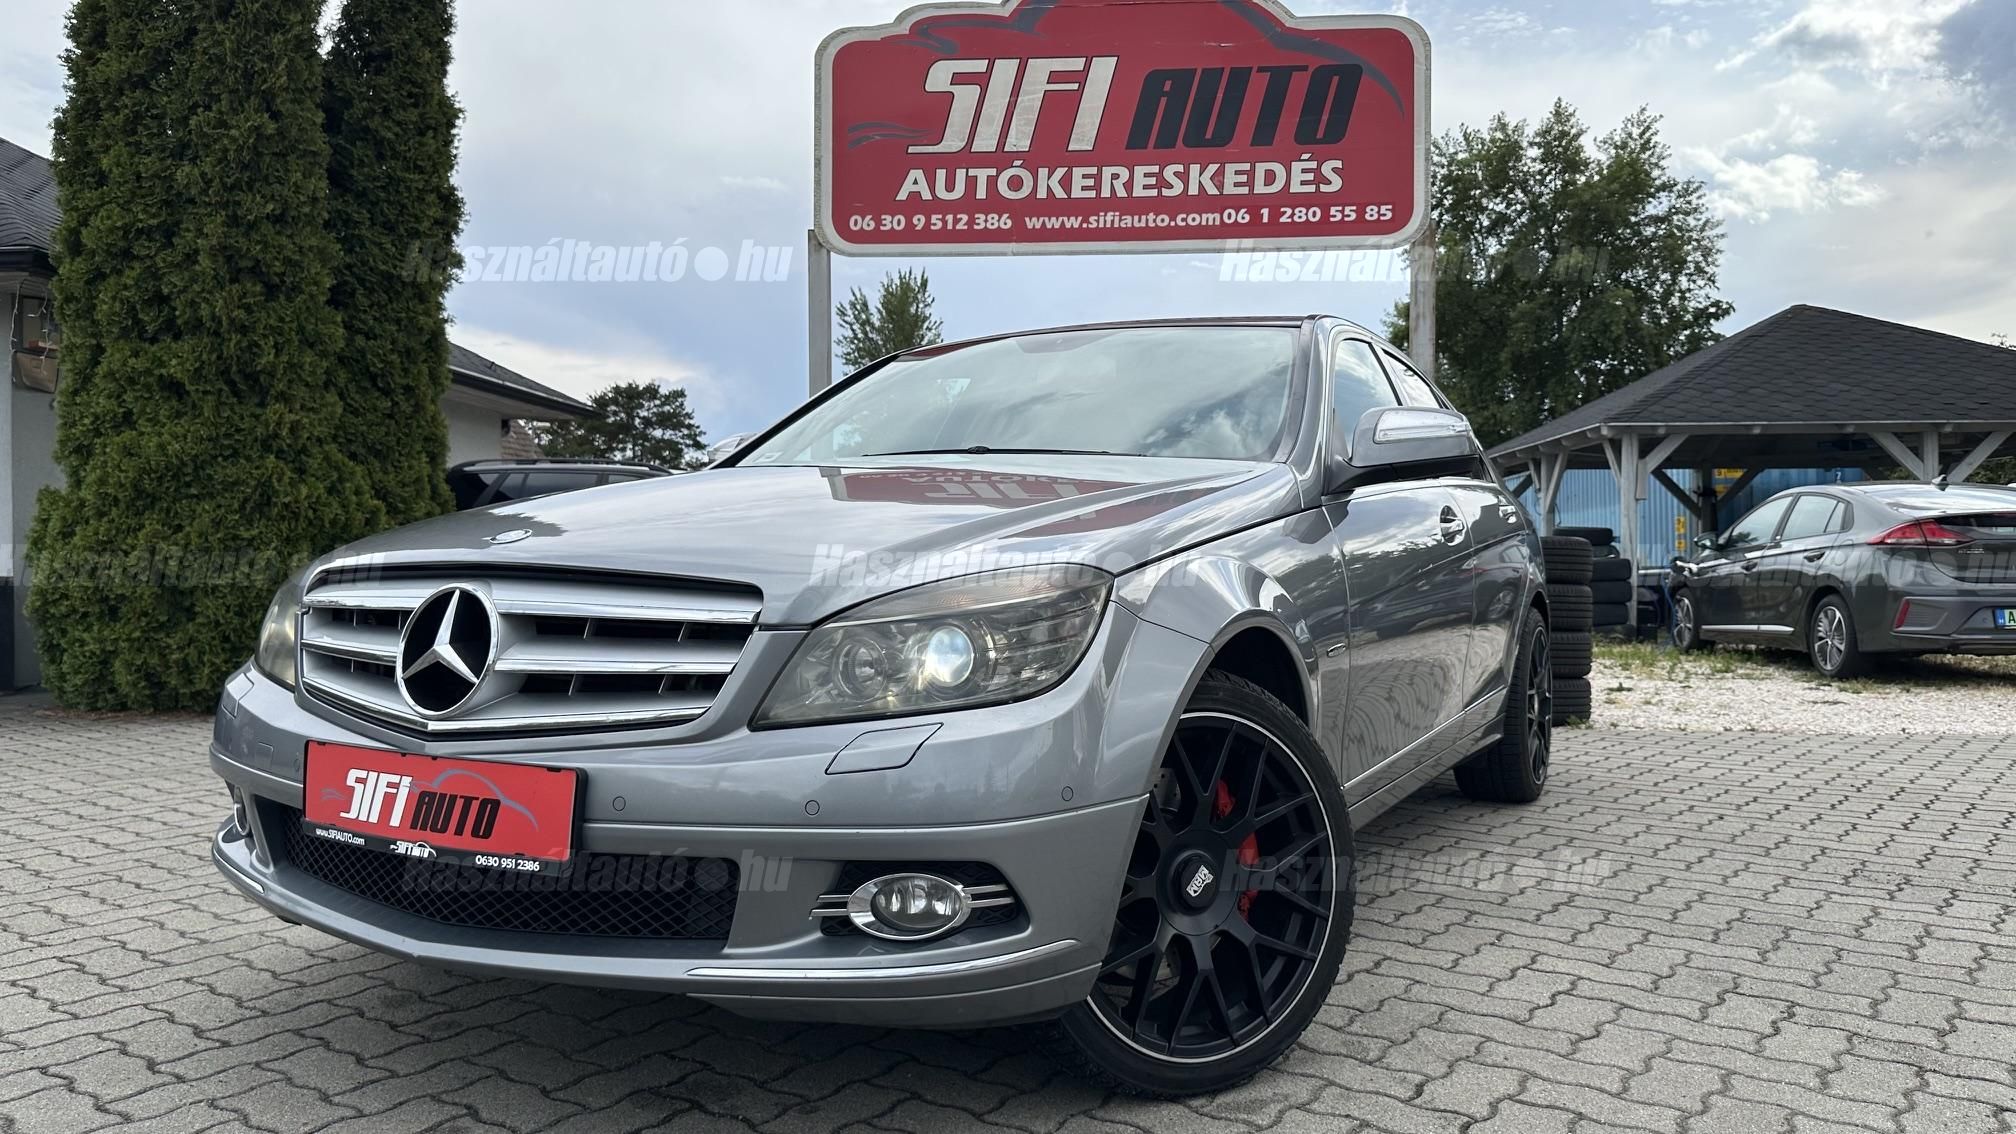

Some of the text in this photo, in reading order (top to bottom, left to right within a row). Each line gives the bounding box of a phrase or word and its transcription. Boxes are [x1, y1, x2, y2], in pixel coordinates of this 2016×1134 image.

[906, 55, 1364, 154] SIFI AUTO
[895, 154, 1344, 201] AUTÓKERESKEDÉS
[850, 204, 1393, 231] 06 30 9 512 386 www.sifiauto.com 06 1 280 55 85
[409, 790, 501, 840] AUTO
[475, 855, 540, 872] 0630 951 2386
